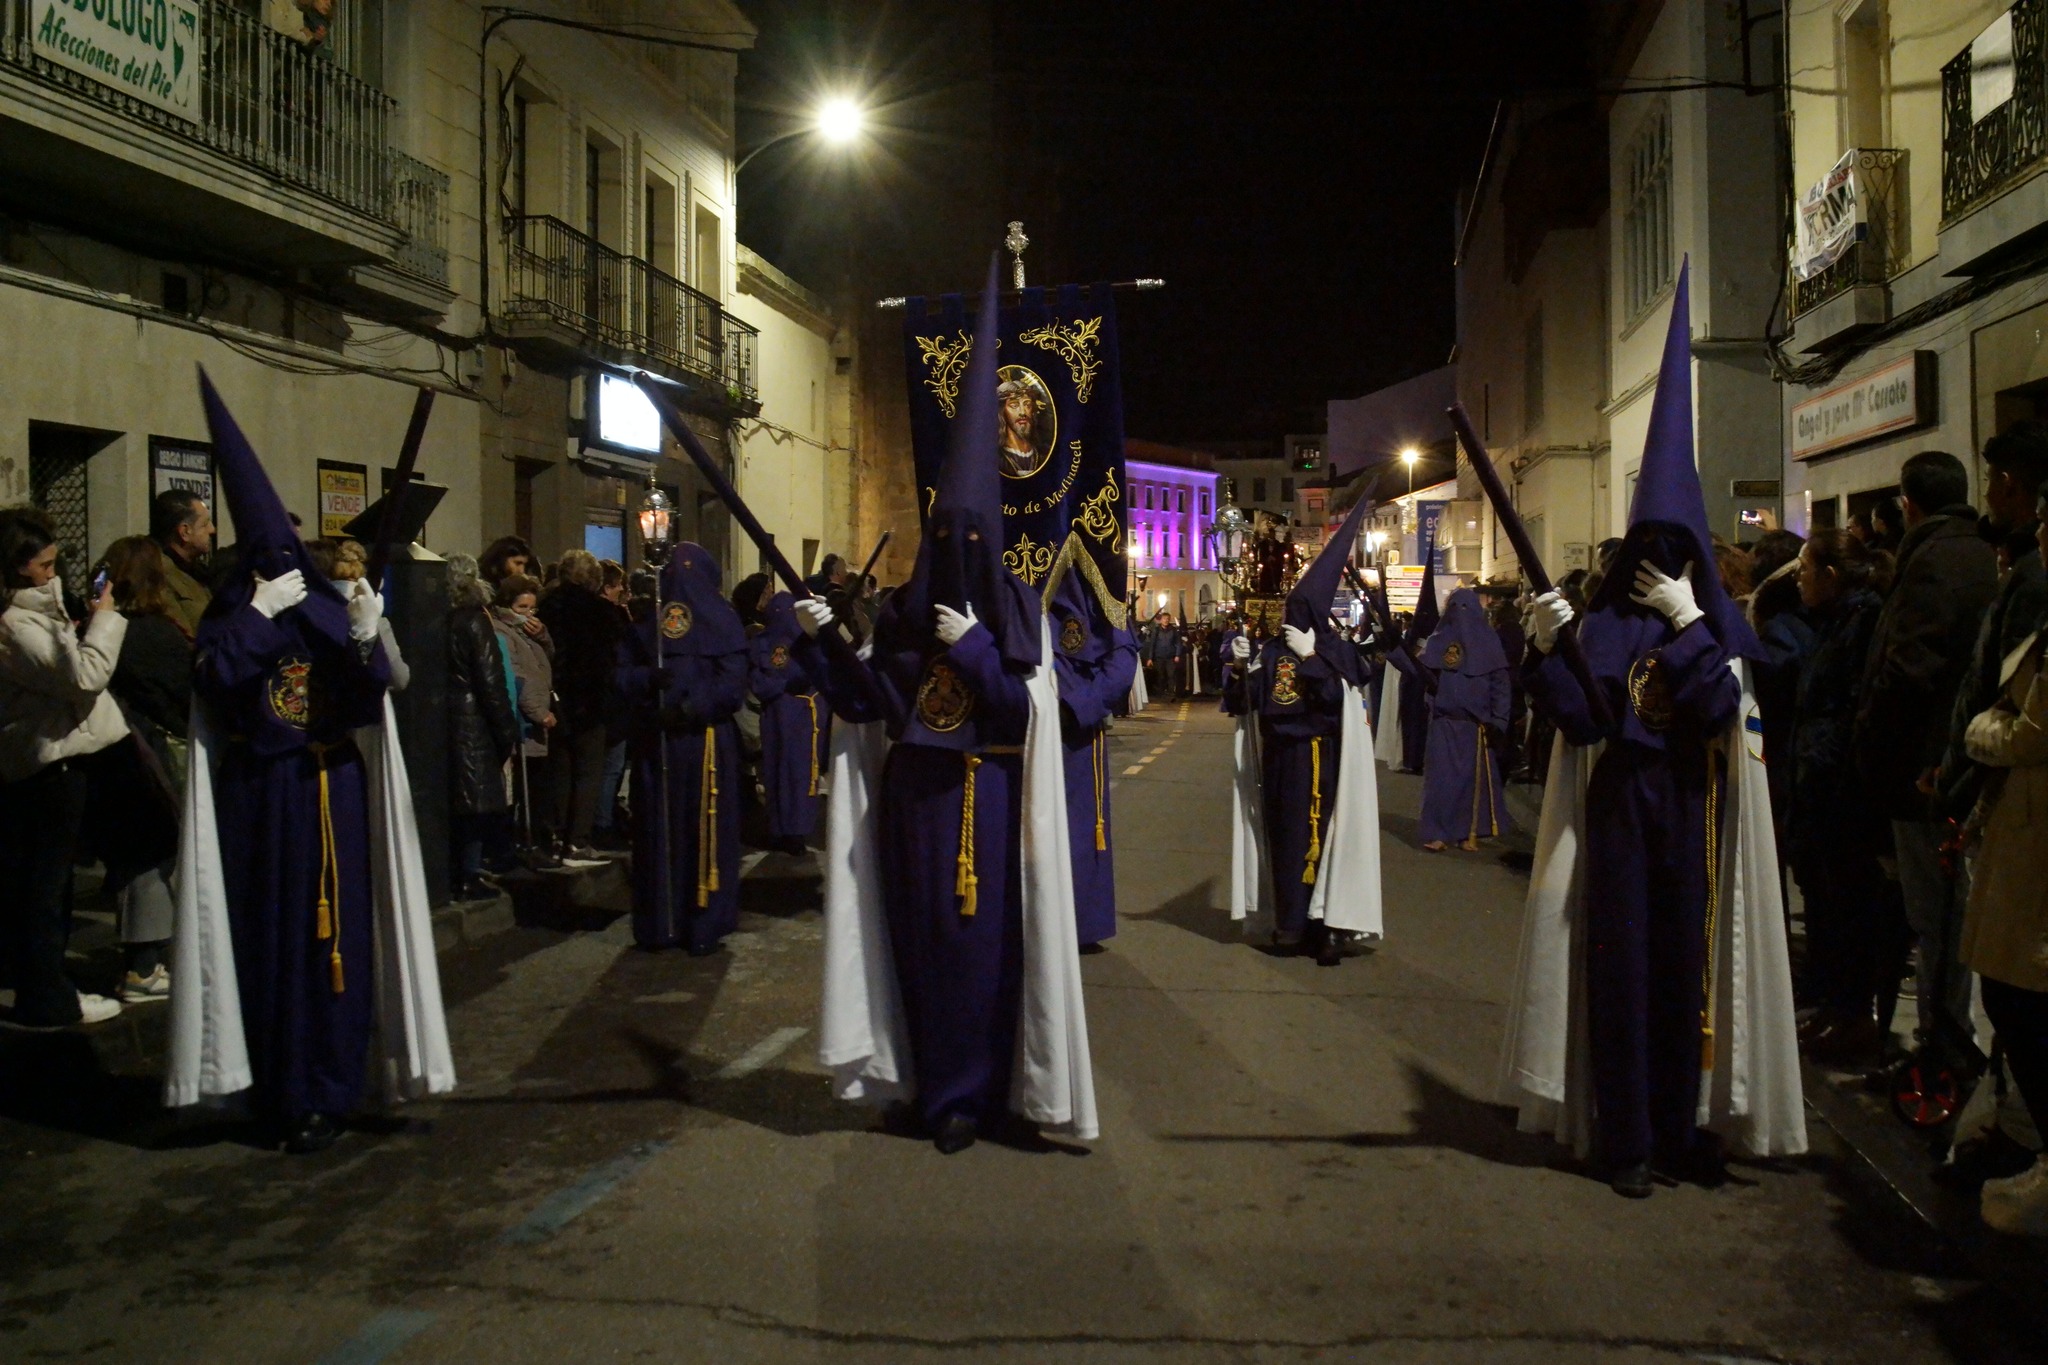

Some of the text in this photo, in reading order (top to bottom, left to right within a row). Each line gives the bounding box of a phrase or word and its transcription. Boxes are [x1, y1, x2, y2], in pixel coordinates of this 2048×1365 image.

[38, 4, 172, 99] Afecciones del Pie
[327, 494, 360, 513] VENDE
[1001, 504, 1018, 517] to
[1024, 500, 1042, 515] de
